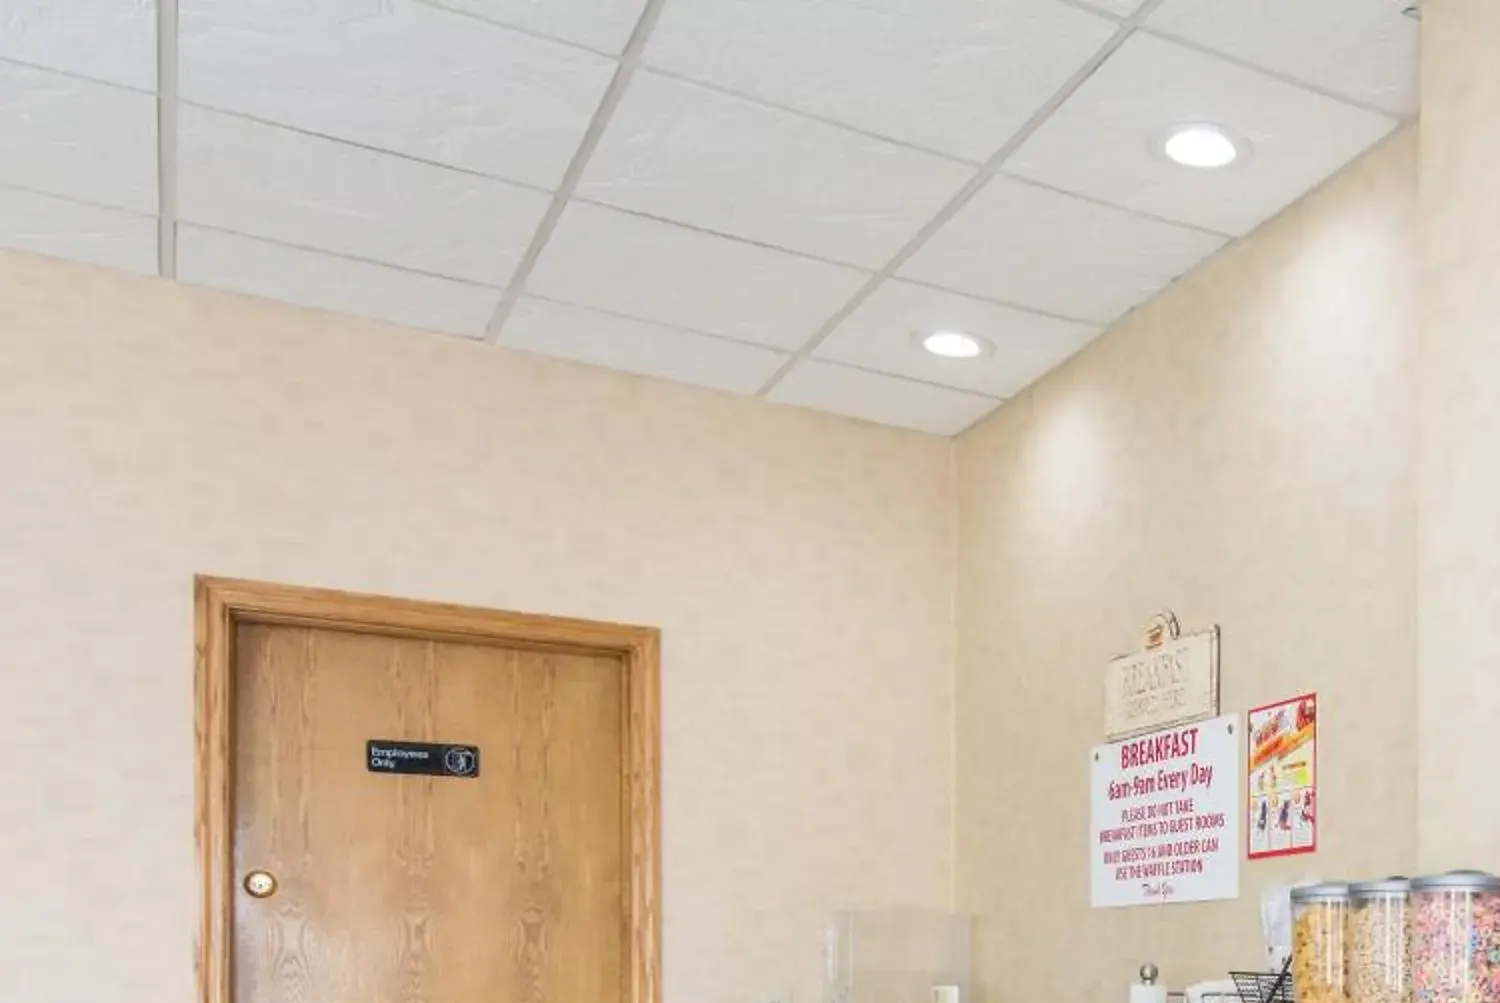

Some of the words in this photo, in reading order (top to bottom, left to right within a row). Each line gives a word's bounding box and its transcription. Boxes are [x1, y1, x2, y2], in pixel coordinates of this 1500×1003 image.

[371, 745, 429, 759] Employees
[1121, 728, 1198, 769] BREAKFAST
[371, 757, 396, 769] Only
[1157, 769, 1188, 792] Every
[1191, 762, 1213, 788] Day
